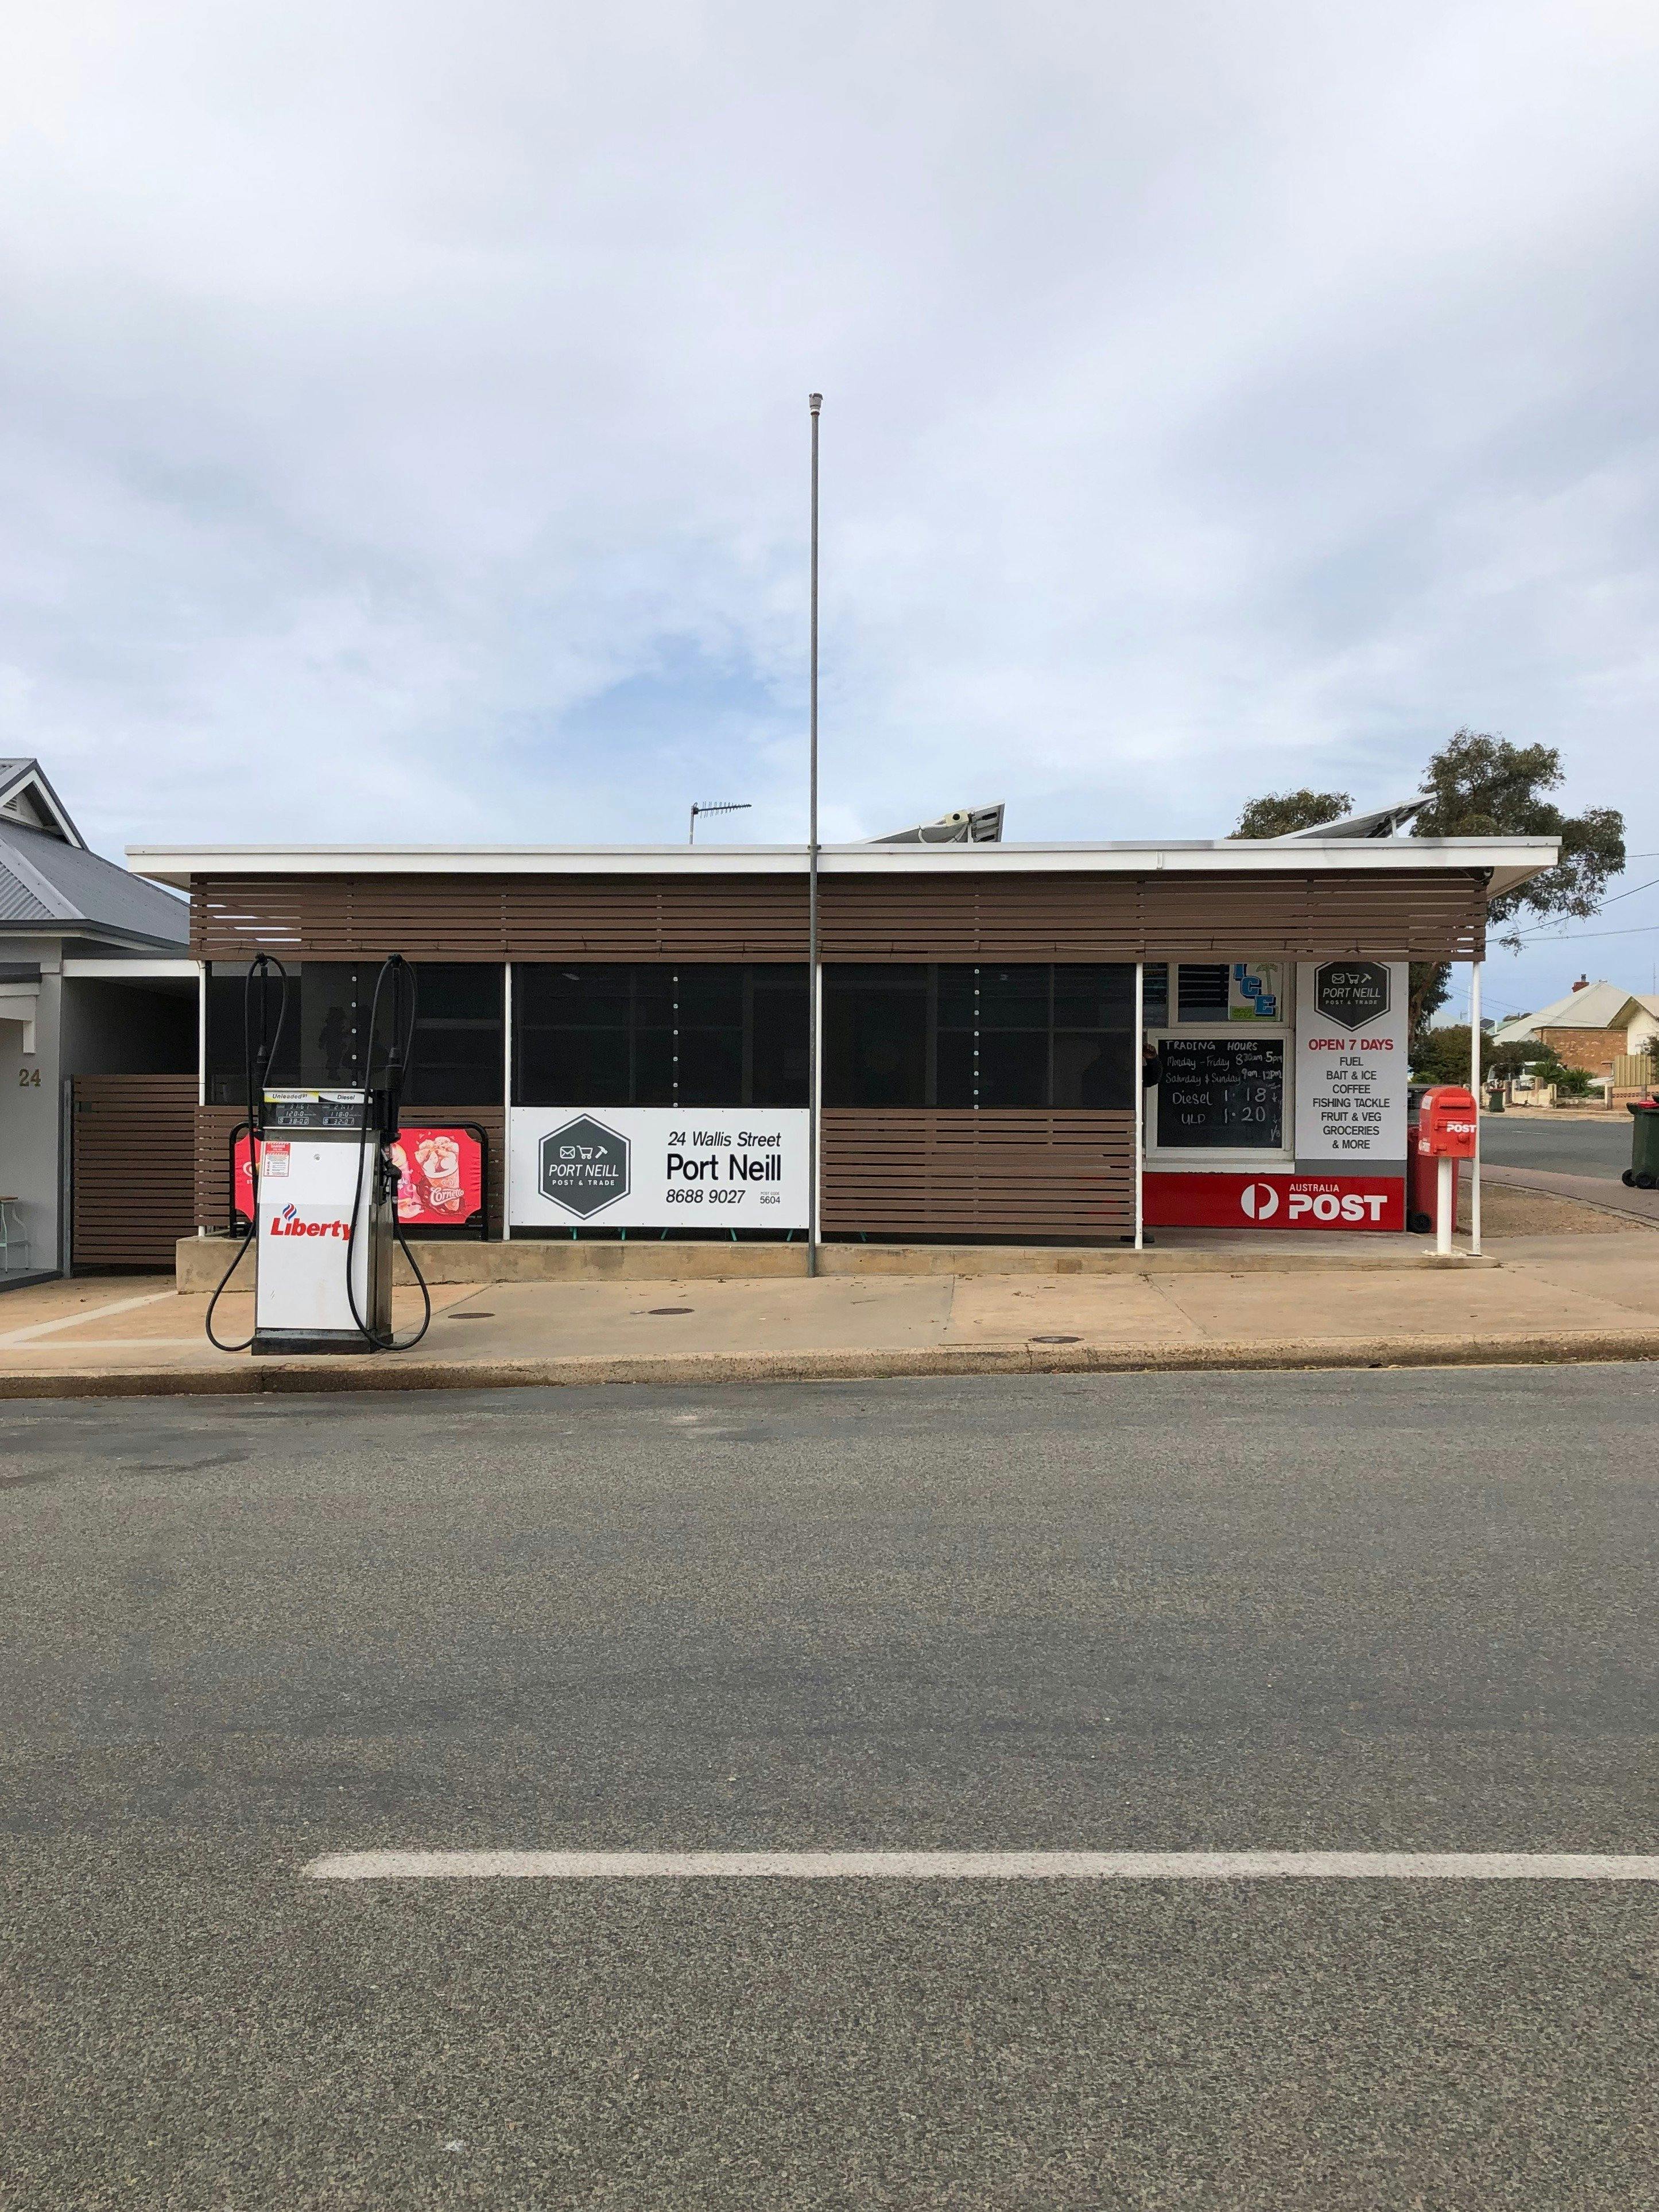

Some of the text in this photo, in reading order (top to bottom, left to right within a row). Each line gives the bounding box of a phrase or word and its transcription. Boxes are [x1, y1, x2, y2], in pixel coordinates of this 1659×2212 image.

[1234, 964, 1277, 1016] ICE
[1323, 987, 1381, 998] PORT NEILL
[1166, 1041, 1258, 1051] TRADING HOURS
[1308, 1039, 1394, 1050] OPEN 7 DAYS
[1167, 1056, 1196, 1070] Monday
[1207, 1055, 1229, 1071] Friday
[1340, 1057, 1363, 1066] FUEL
[19, 1068, 41, 1087] 24
[1166, 1073, 1201, 1086] Saturday
[1212, 1073, 1241, 1086] Sunday
[1326, 1070, 1377, 1080] BAIT & ICE
[1332, 1084, 1371, 1094] COFFEE
[1172, 1090, 1213, 1105] Diesel
[1312, 1098, 1390, 1108] FISHING TACKLE
[1181, 1113, 1206, 1125] ULP
[1321, 1112, 1382, 1121] FRUIT & VEG
[1323, 1126, 1379, 1135] GROCERIES
[1447, 1124, 1476, 1133] POST
[668, 1131, 781, 1147] 24 Wallis Street
[1332, 1139, 1370, 1149] & MORE
[549, 1164, 619, 1177] PORT NEILL
[666, 1153, 781, 1181] Port Neill
[1289, 1183, 1339, 1192] AUSTRALIA
[431, 1187, 465, 1206] Cornetto
[666, 1189, 746, 1204] 8688 9027
[759, 1196, 781, 1204] 5604
[1289, 1194, 1387, 1221] POST
[270, 1217, 351, 1241] Liberty
